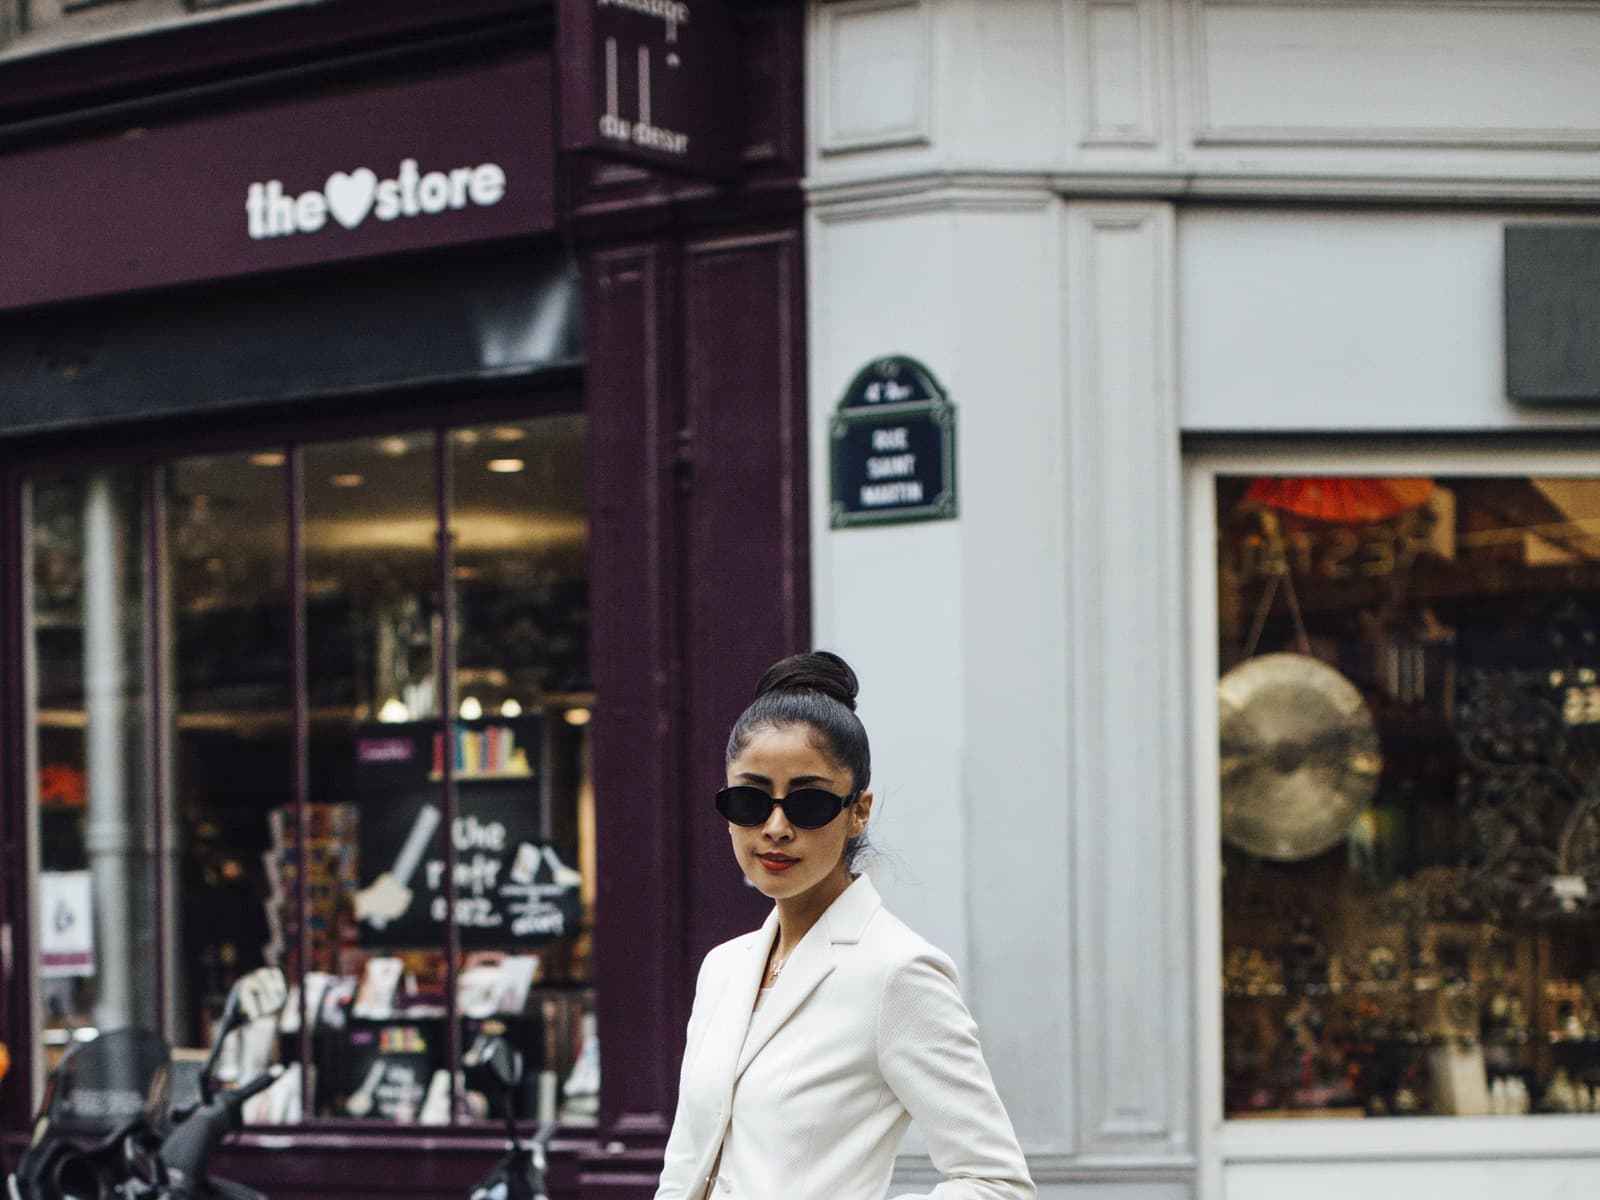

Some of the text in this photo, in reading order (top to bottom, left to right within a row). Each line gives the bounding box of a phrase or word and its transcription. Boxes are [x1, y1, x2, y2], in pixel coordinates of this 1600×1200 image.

[246, 157, 506, 240] the store
[873, 427, 908, 450] RUE
[867, 453, 916, 479] SAINT
[860, 481, 923, 505] MARTIN
